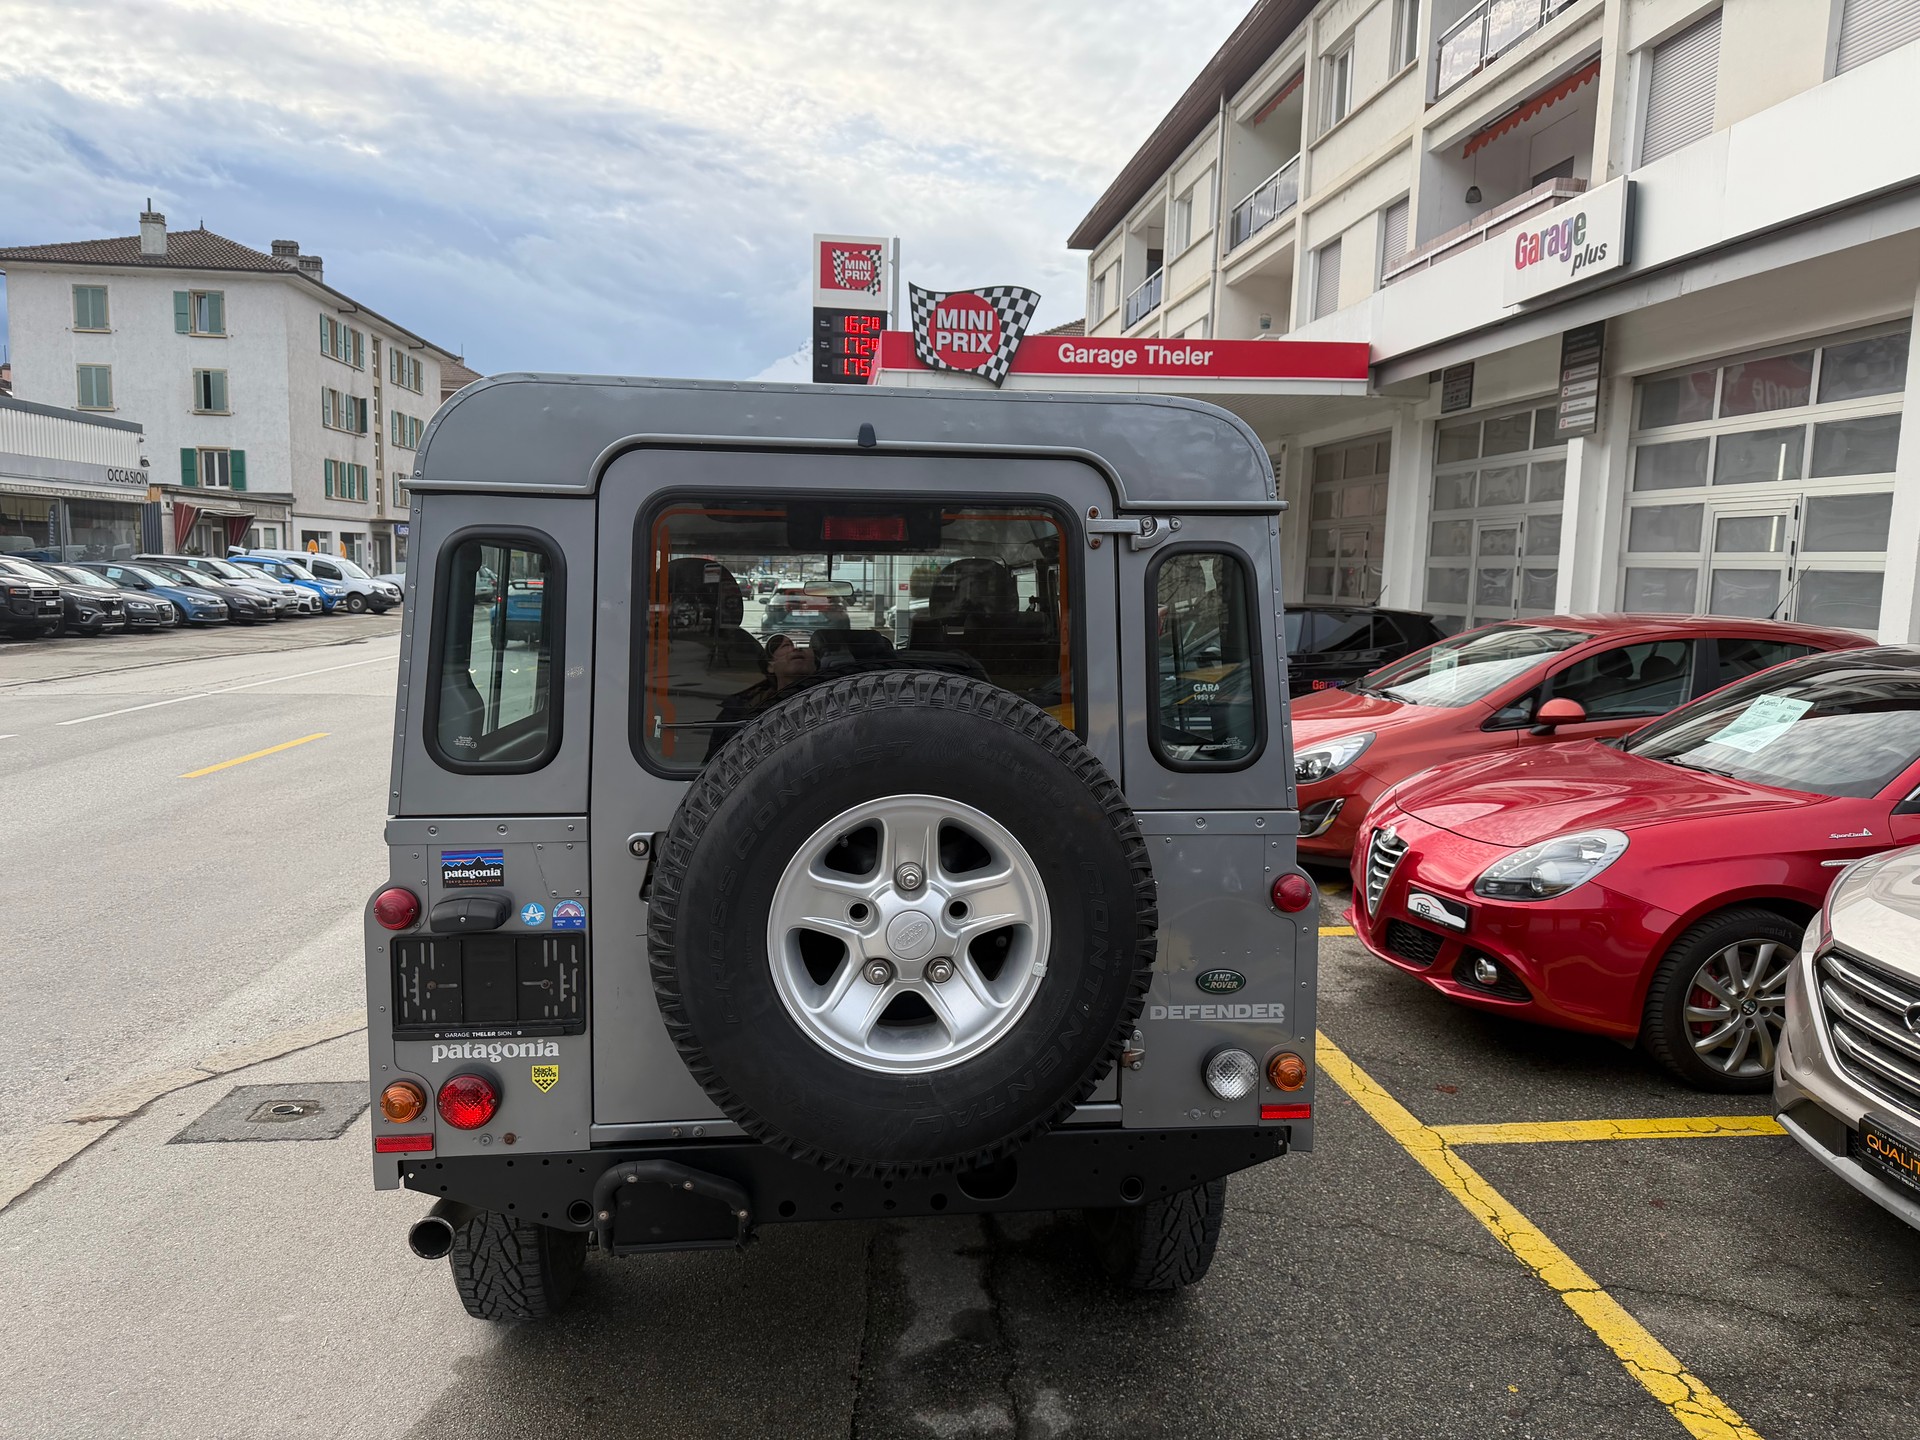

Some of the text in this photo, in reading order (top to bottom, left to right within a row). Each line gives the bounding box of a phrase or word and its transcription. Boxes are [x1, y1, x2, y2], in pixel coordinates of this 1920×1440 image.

[1515, 212, 1587, 270] Garage
[845, 259, 871, 270] MINI
[1571, 243, 1607, 277] plus
[845, 270, 871, 280] PRIX
[936, 308, 994, 331] MINI
[936, 332, 993, 354] PRIX
[1058, 343, 1213, 368] Garage Theler
[107, 468, 148, 485] OCCASION
[444, 867, 501, 880] patagonia
[1208, 973, 1232, 982] LAND
[1209, 981, 1238, 989] ROVER
[1150, 1003, 1285, 1020] DEFENDER
[431, 1039, 560, 1063] patagonia
